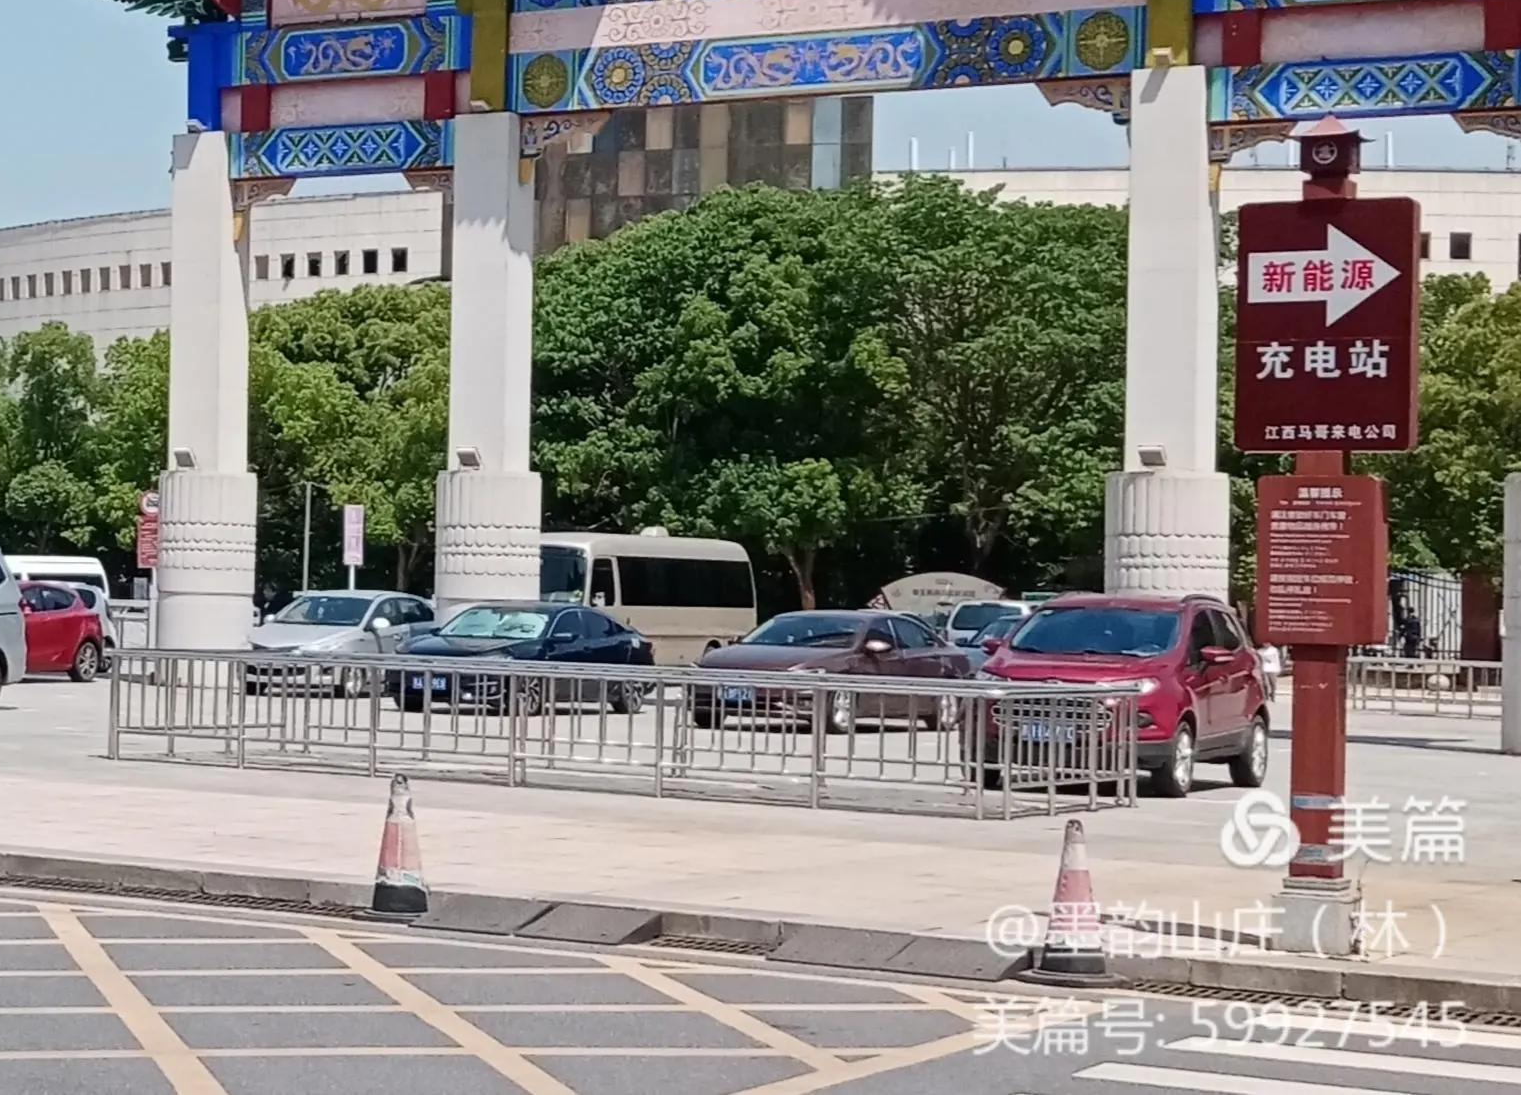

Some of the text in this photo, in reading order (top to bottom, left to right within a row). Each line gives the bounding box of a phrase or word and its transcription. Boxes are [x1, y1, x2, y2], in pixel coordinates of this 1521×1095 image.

[1262, 259, 1375, 293] 新能源
[1256, 339, 1390, 380] 充电站
[1264, 424, 1397, 440] 江西马哥来电公司
